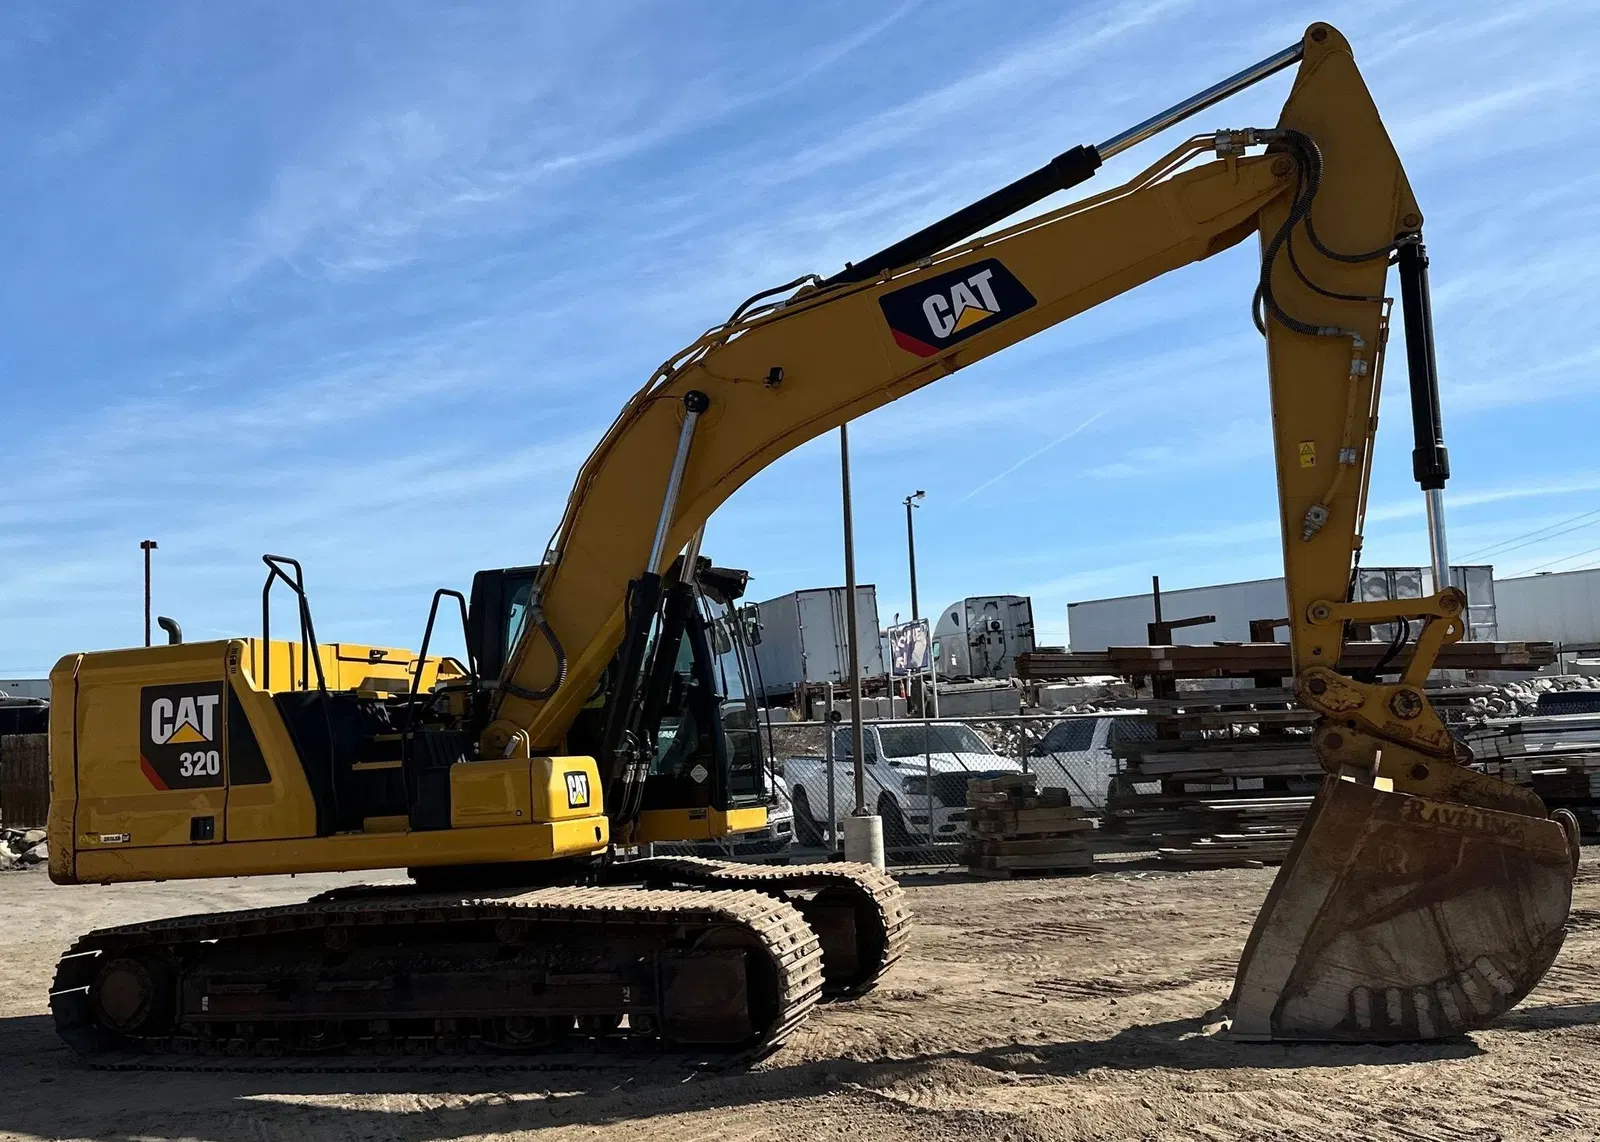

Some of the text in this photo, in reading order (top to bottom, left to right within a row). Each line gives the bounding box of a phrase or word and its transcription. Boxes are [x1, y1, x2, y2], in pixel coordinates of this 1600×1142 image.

[922, 268, 1001, 339] CAT
[151, 694, 219, 745] CAT
[179, 750, 220, 777] 320
[567, 774, 587, 805] CAT
